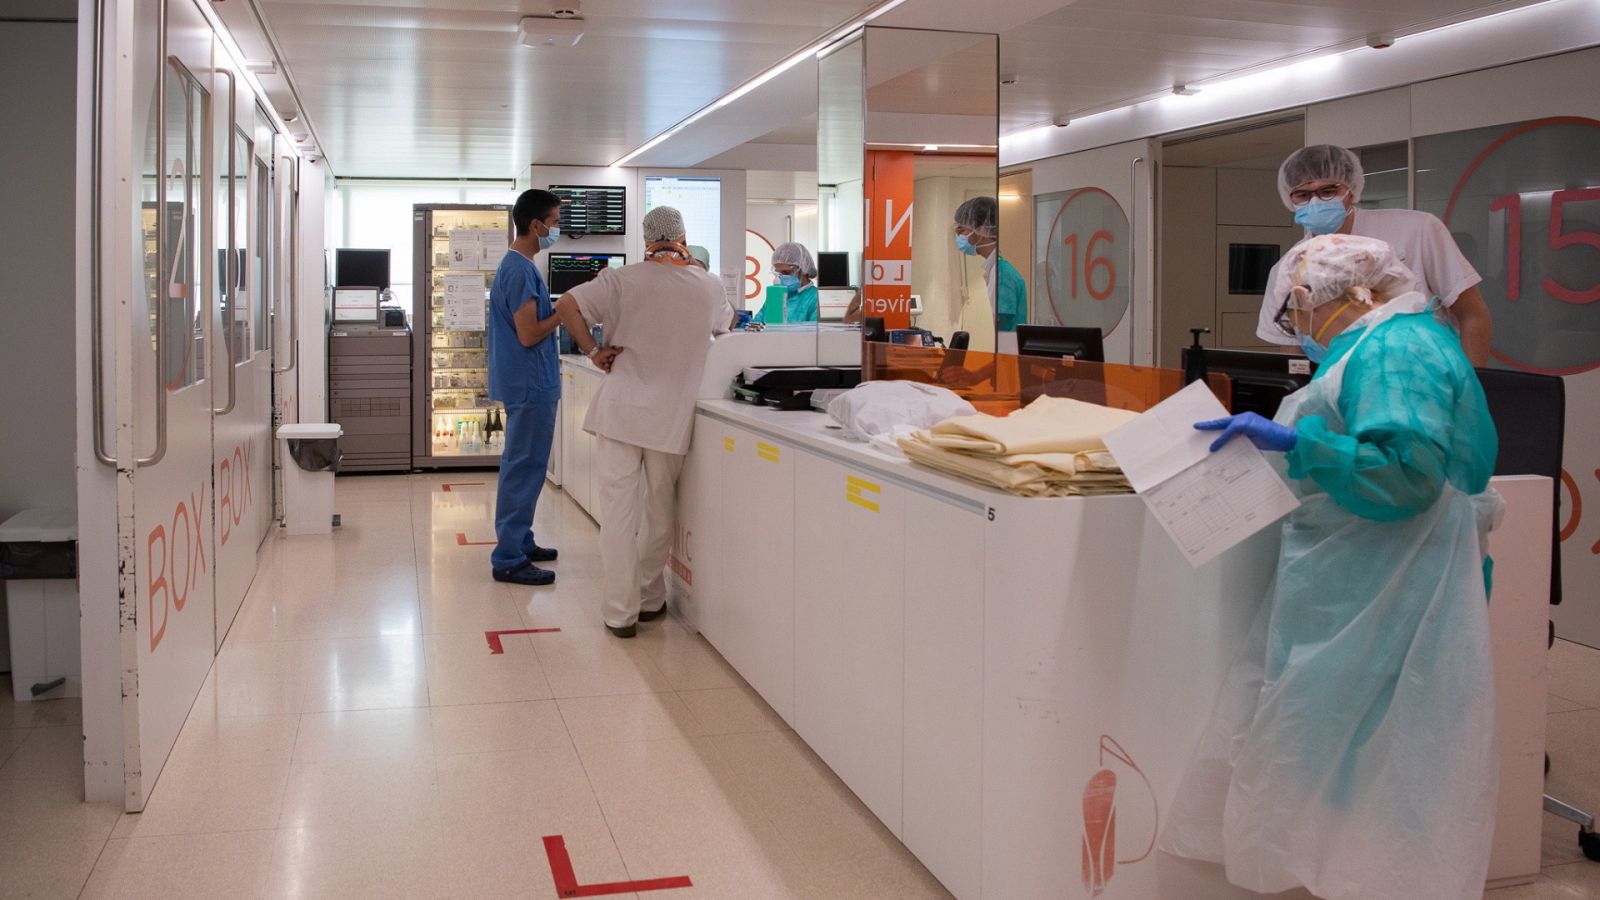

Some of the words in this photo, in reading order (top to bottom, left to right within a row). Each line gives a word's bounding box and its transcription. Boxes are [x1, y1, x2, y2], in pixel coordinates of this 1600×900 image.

[1064, 231, 1116, 301] 16
[1488, 188, 1600, 304] 15
[220, 434, 252, 546] BOX
[987, 507, 996, 521] 5
[147, 480, 207, 654] BOX
